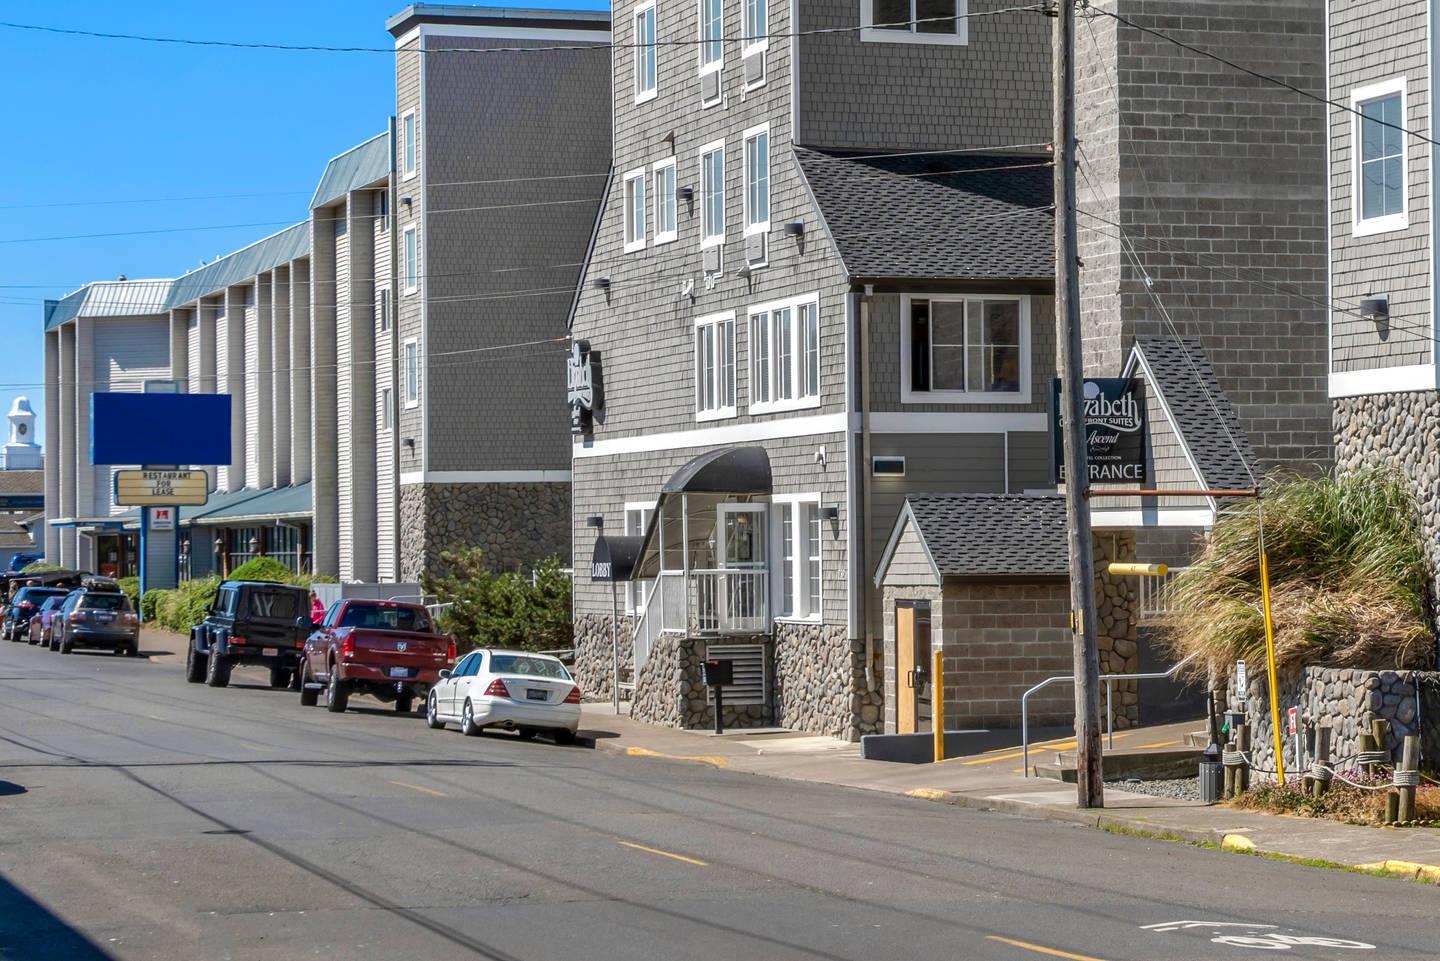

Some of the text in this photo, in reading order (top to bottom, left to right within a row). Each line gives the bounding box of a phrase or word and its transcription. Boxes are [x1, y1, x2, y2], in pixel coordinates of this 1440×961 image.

[1058, 392, 1142, 428] zabeth
[1108, 418, 1133, 427] SUITES
[1087, 430, 1120, 445] Ascend
[1059, 464, 1143, 479] ERANCE
[152, 487, 175, 496] LEASE
[592, 562, 612, 578] LOBBY
